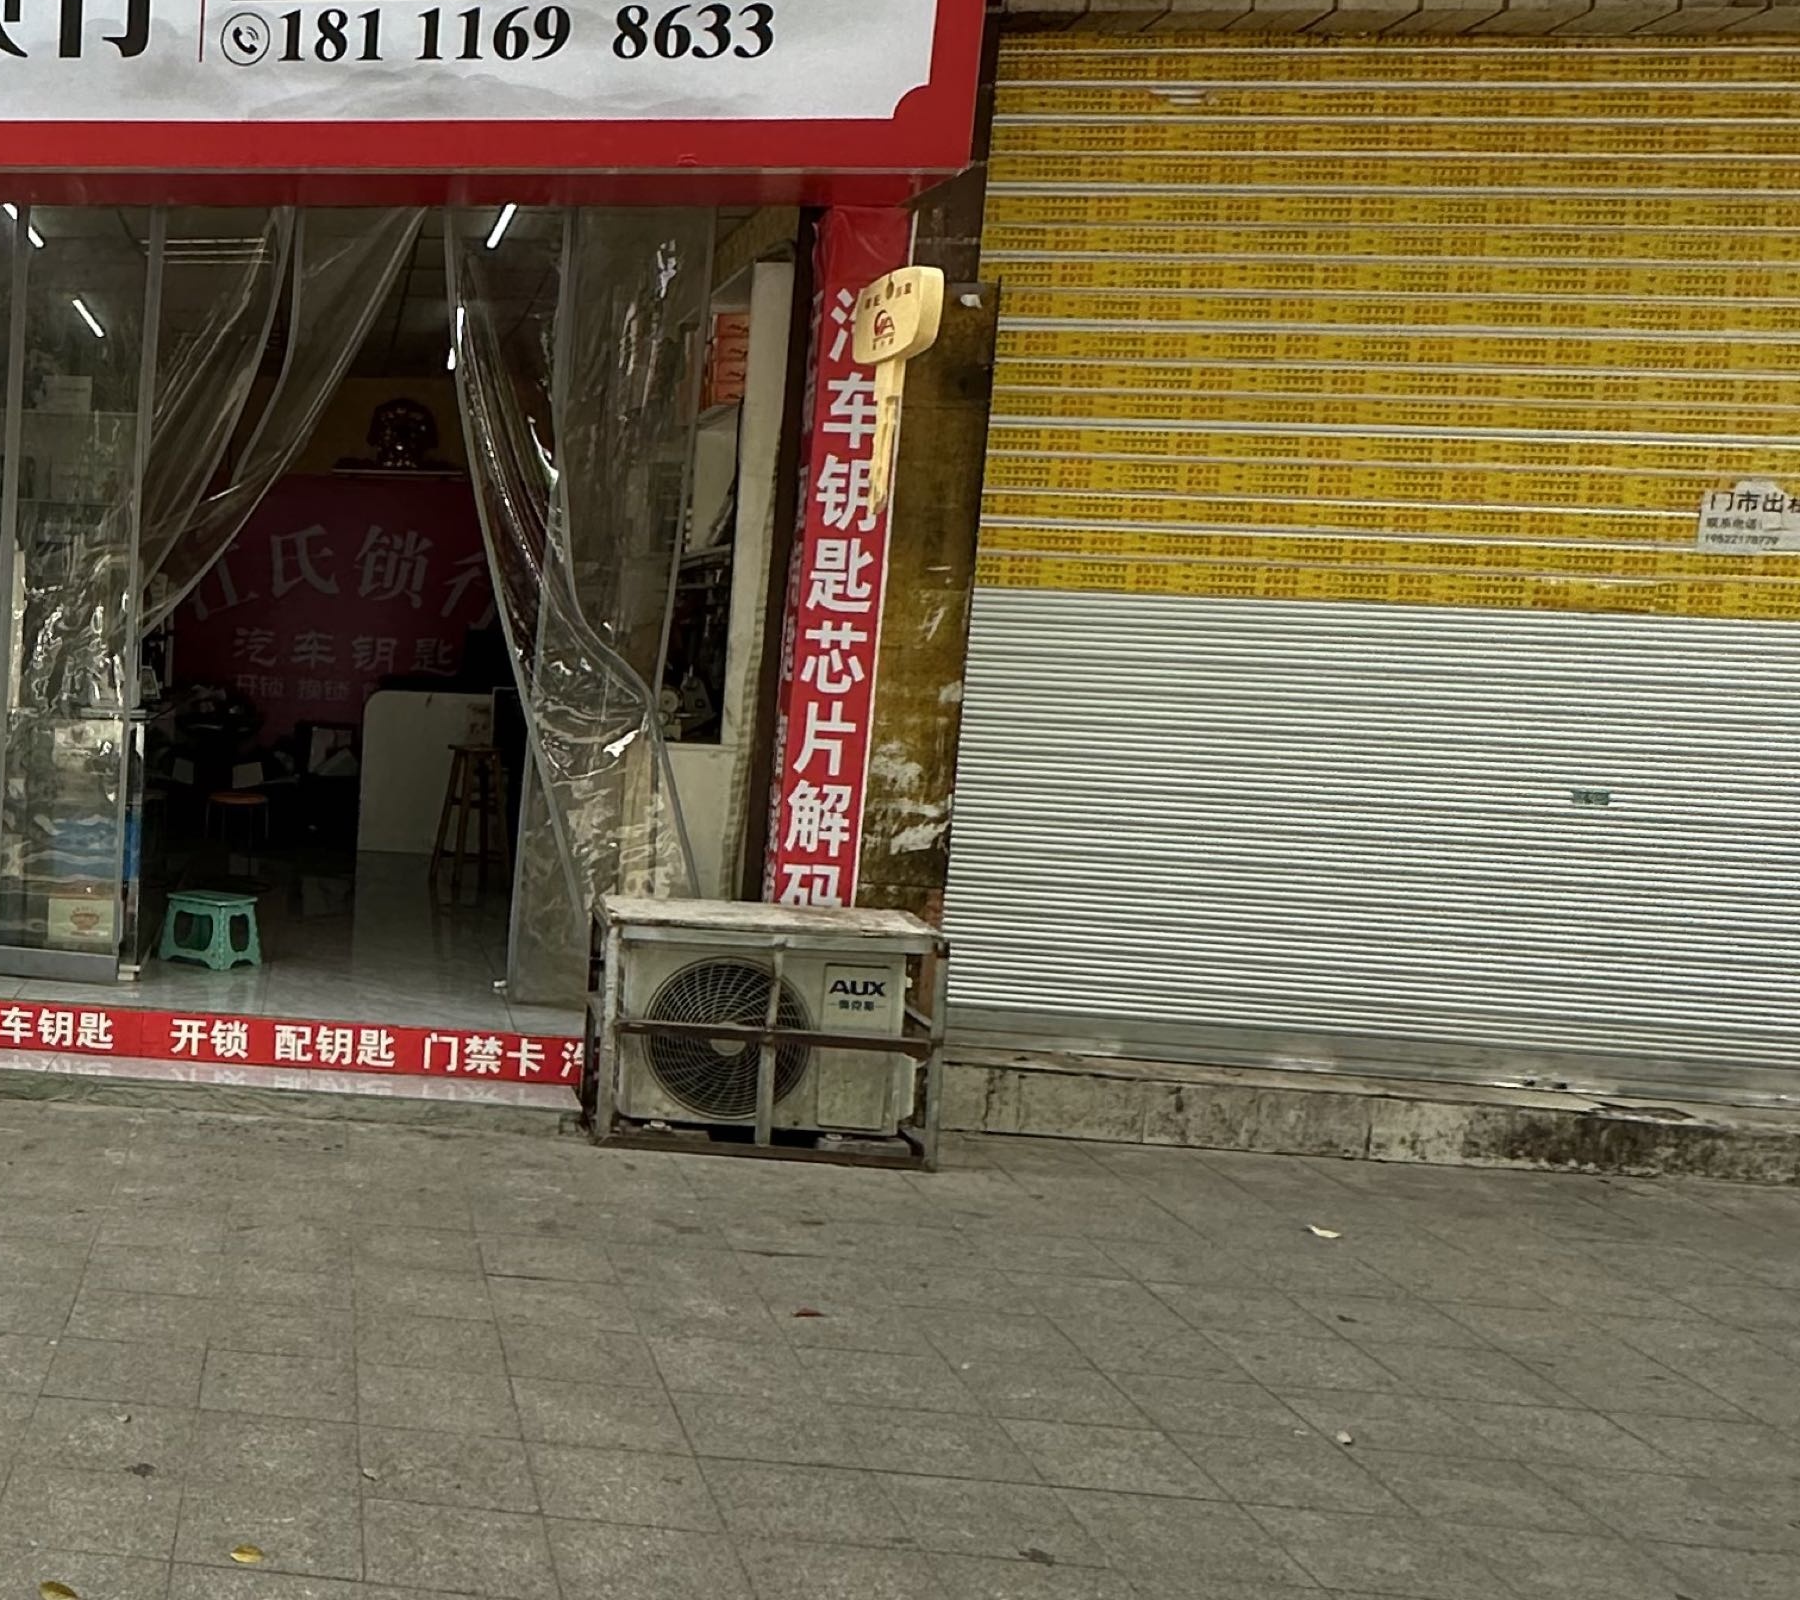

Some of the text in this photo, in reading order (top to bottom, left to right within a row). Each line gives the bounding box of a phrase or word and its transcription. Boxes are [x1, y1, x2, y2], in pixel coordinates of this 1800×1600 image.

[277, 2, 775, 64] 181 1169 8633
[779, 287, 881, 907] 车钥匙芯片解码
[233, 626, 458, 678] 汽车钥匙
[829, 979, 886, 997] AUX
[169, 1017, 248, 1059] 开锁
[274, 1023, 396, 1068] 配钥匙
[423, 1032, 546, 1077] 门禁卡
